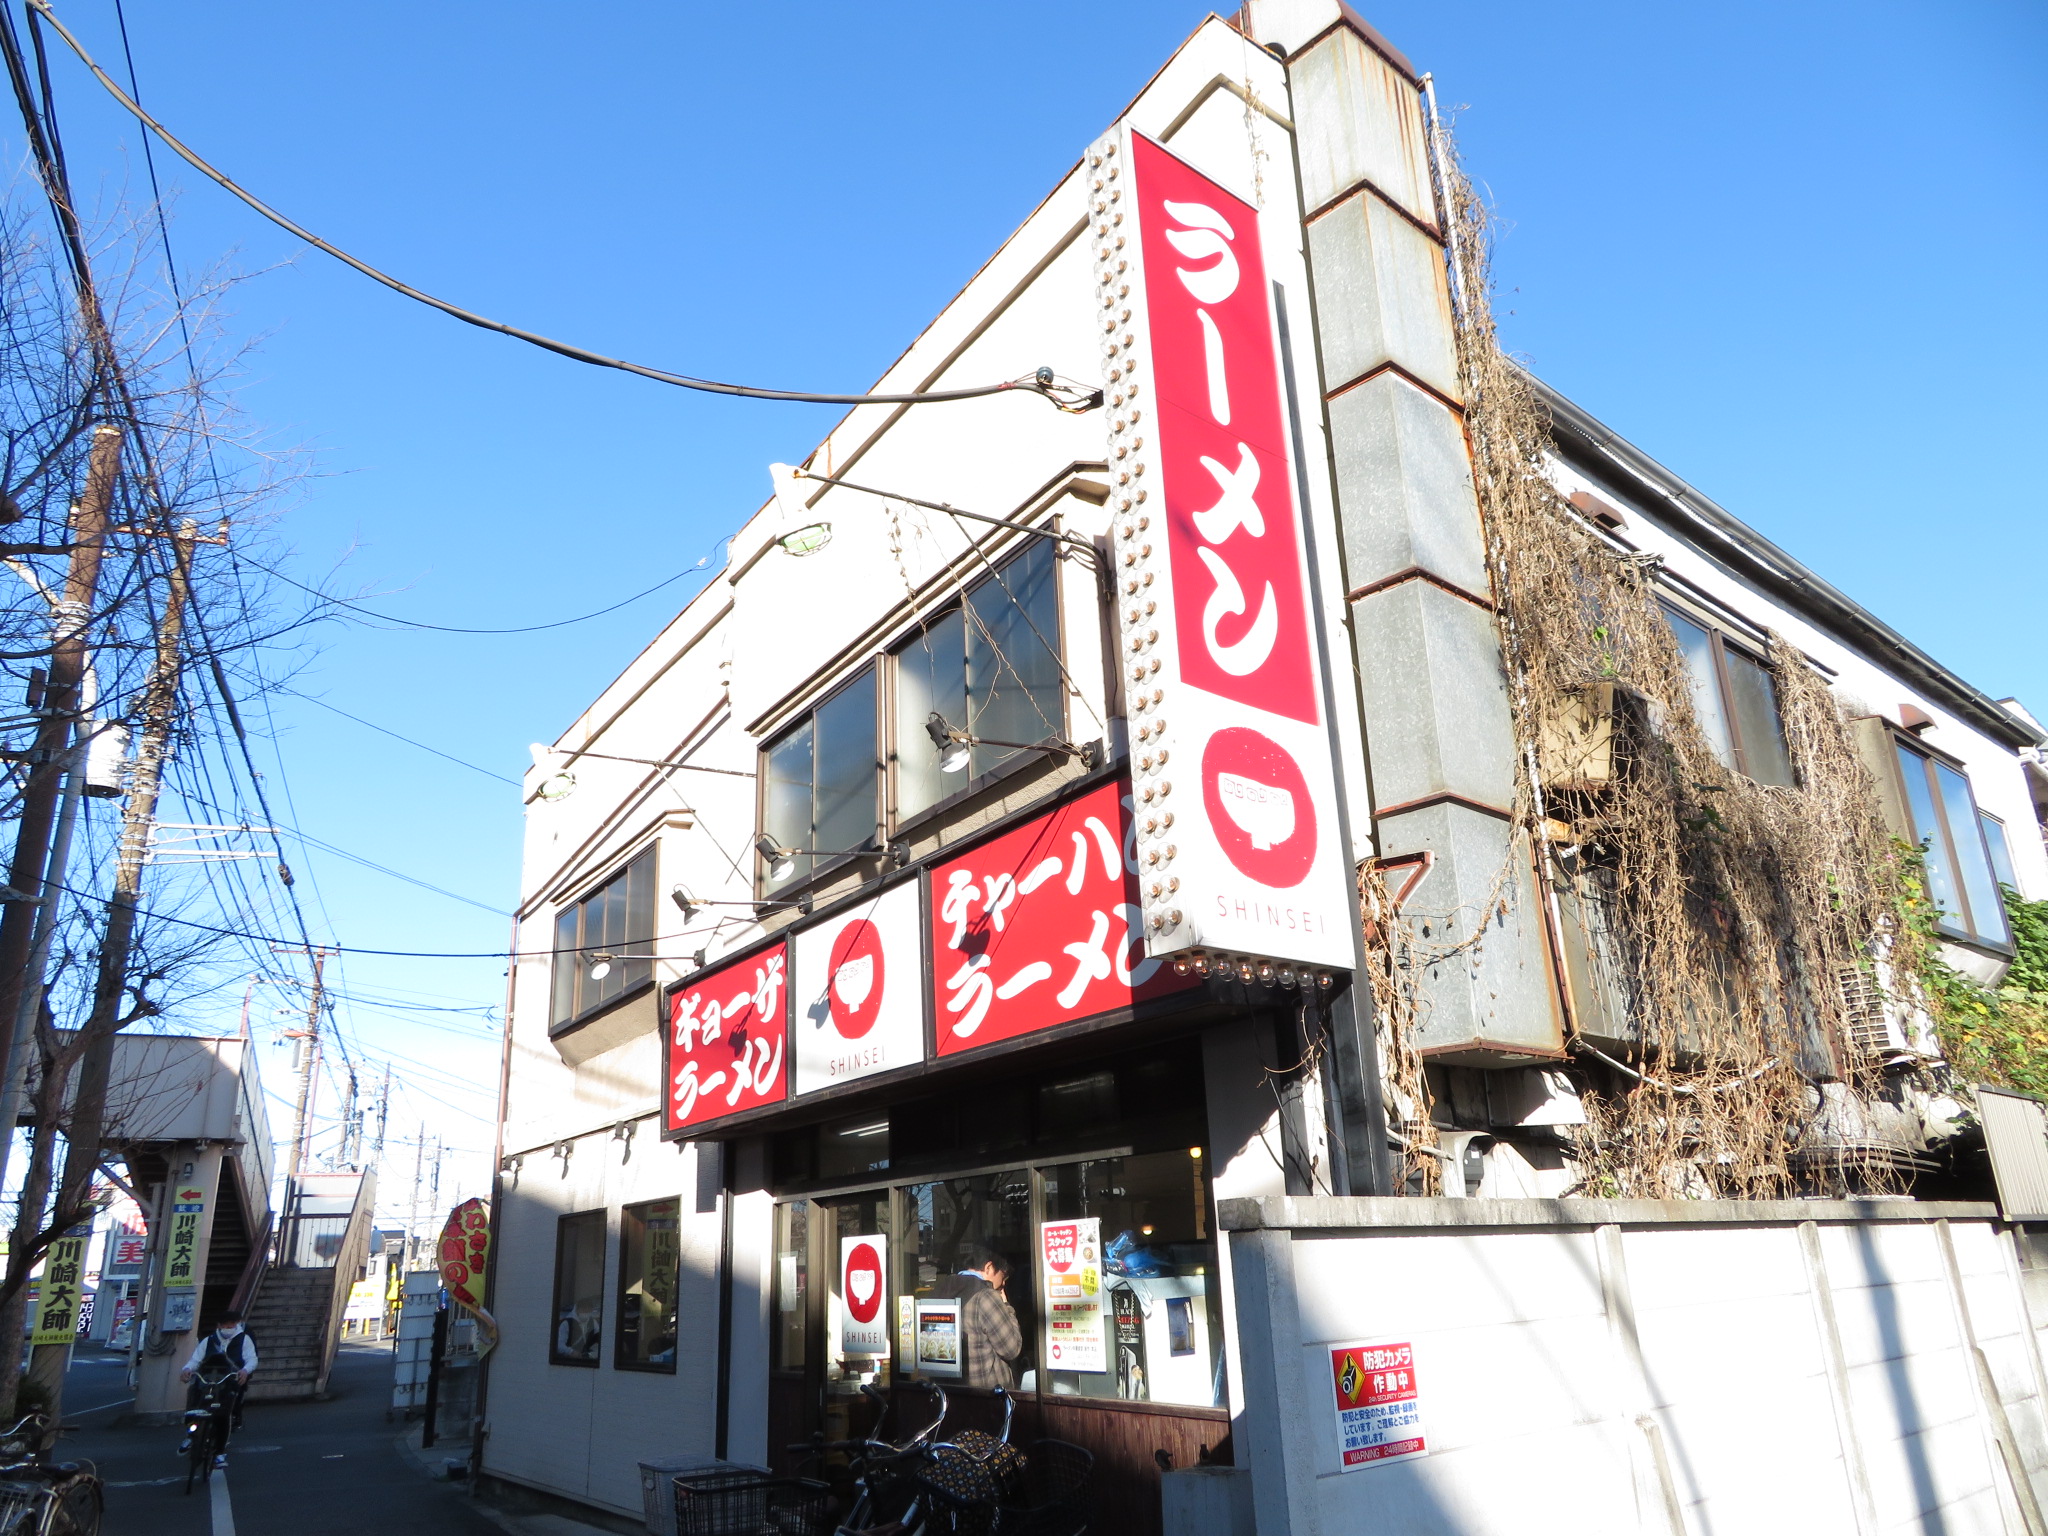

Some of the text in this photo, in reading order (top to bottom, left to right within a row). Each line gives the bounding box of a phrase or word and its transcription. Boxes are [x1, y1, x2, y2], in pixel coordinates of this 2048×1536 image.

[1163, 199, 1279, 677] ラーメン
[1217, 894, 1325, 935] SHINSEI
[946, 902, 1164, 1038] ラーメン
[675, 952, 785, 1054] ギョーザ
[674, 1033, 782, 1121] ラーメン
[829, 1045, 886, 1077] SHINSEI
[170, 1214, 197, 1278] 川崎大師
[1047, 1236, 1073, 1247] スタッフ
[1048, 1247, 1074, 1263] 大募集
[41, 1239, 83, 1332] 川崎大師
[846, 1331, 882, 1344] SHINSEI
[1362, 1347, 1411, 1371] 防犯カメラ
[1373, 1370, 1409, 1394] 作動中
[1377, 1393, 1397, 1402] SECURITY
[1349, 1447, 1380, 1463] WARNING
